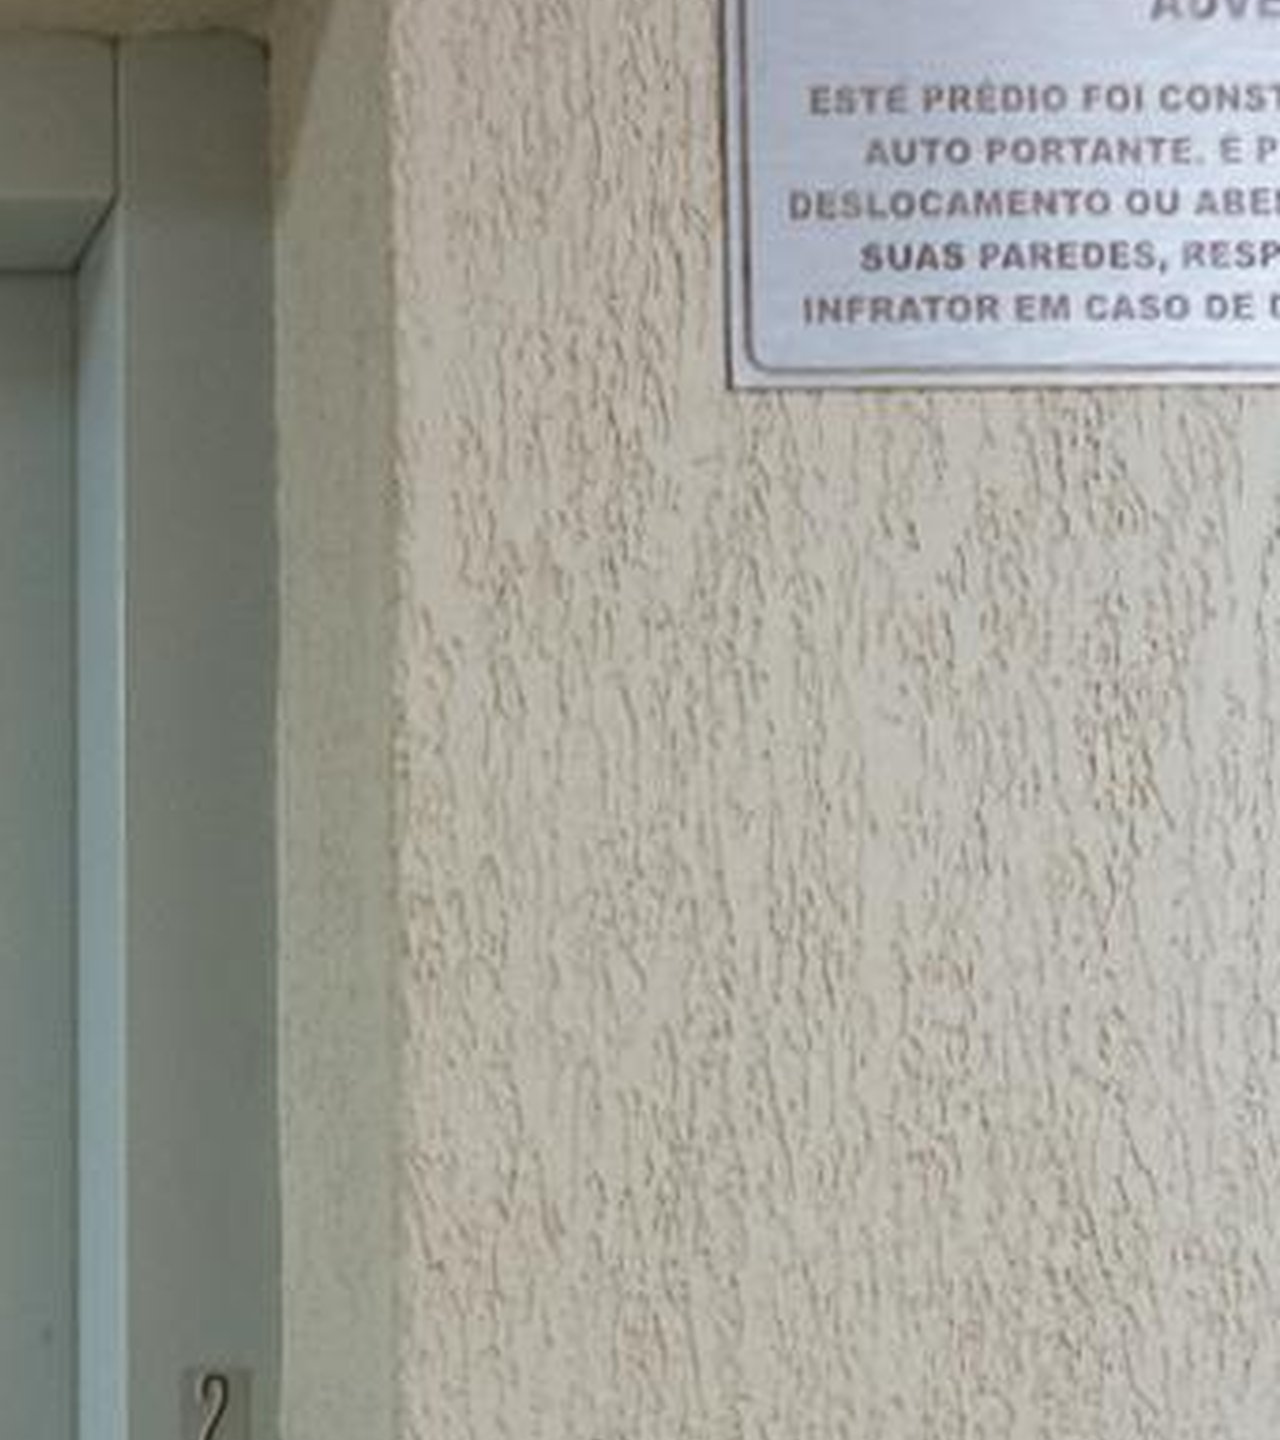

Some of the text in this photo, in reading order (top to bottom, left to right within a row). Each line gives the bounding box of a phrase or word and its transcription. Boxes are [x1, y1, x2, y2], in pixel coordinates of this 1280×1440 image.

[809, 84, 908, 115] ESTE
[923, 75, 1068, 113] PRÉDIO
[1083, 83, 1144, 112] FOI
[865, 137, 972, 166] AUTO
[789, 187, 1280, 220] DESLOCAMENTO OU ABE
[860, 240, 1280, 275] SUAS PAREDES, RESP
[803, 295, 1000, 324] INFRATOR
[1014, 294, 1071, 322] EM
[1085, 293, 1190, 321] CASO
[1205, 292, 1254, 321] DE
